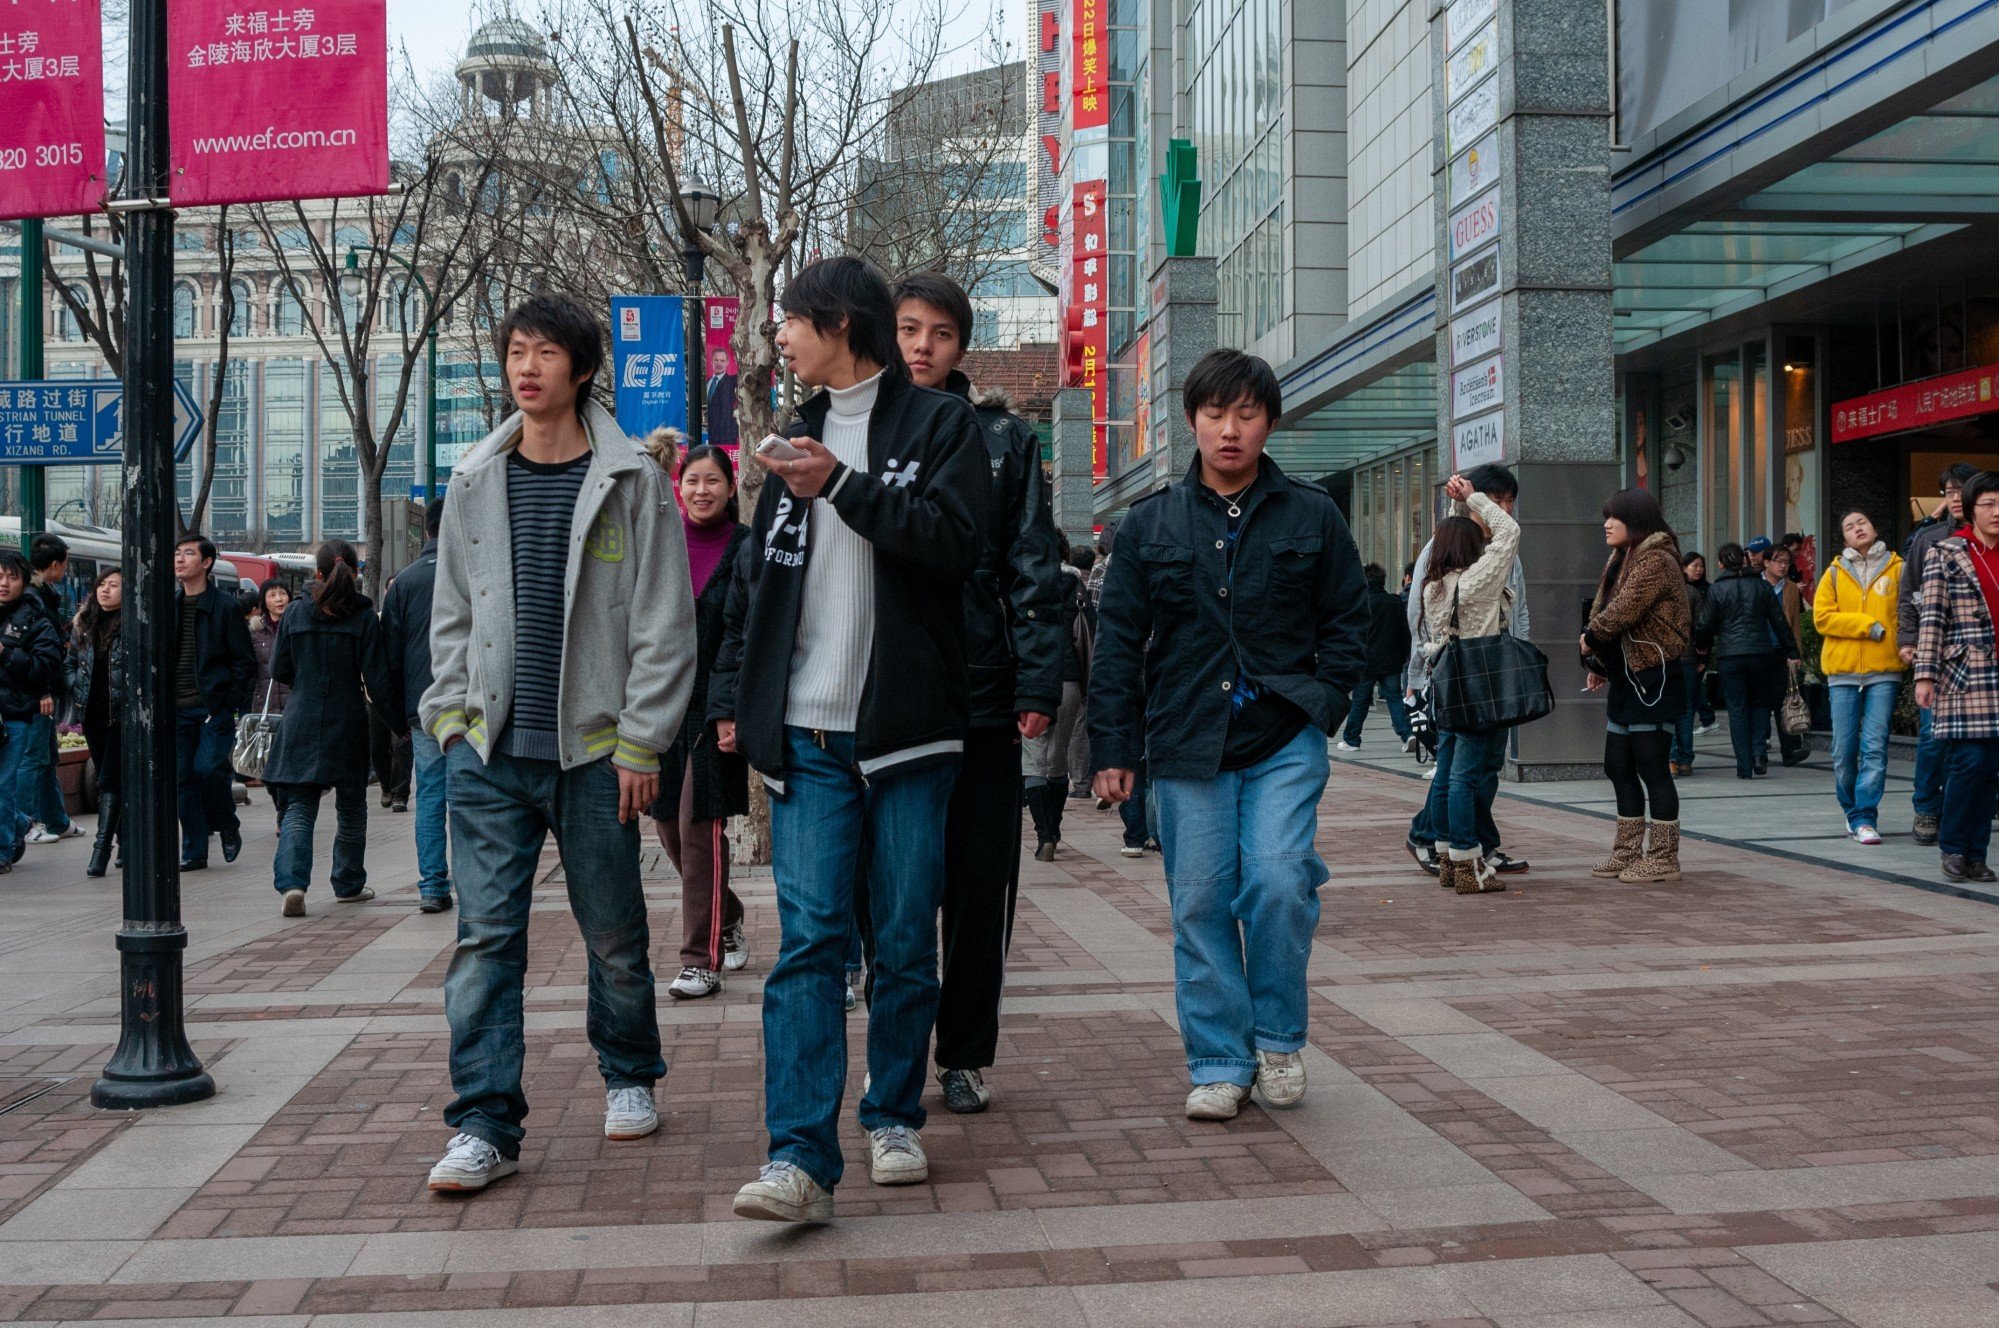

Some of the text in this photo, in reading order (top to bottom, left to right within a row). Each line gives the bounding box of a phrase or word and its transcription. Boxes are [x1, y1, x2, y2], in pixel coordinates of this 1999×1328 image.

[225, 8, 315, 36] 来福士旁
[187, 34, 358, 68] 金陵海欣大厦3层
[0, 55, 80, 83] 大厦3层
[193, 126, 356, 154] www.ef.com.cn
[35, 143, 83, 167] 3015
[1455, 201, 1494, 248] GUESS
[1458, 264, 1496, 292] SISLEY
[1456, 316, 1497, 350] RIVERSTONE
[622, 353, 678, 388] EF
[1459, 372, 1488, 396] Andersen's
[44, 411, 86, 421] TUNNEL
[1848, 399, 1898, 429] 来福士广场
[5, 422, 78, 444] 行地道
[1460, 421, 1498, 453] AGATHA
[6, 445, 72, 456] XIZANG RD.
